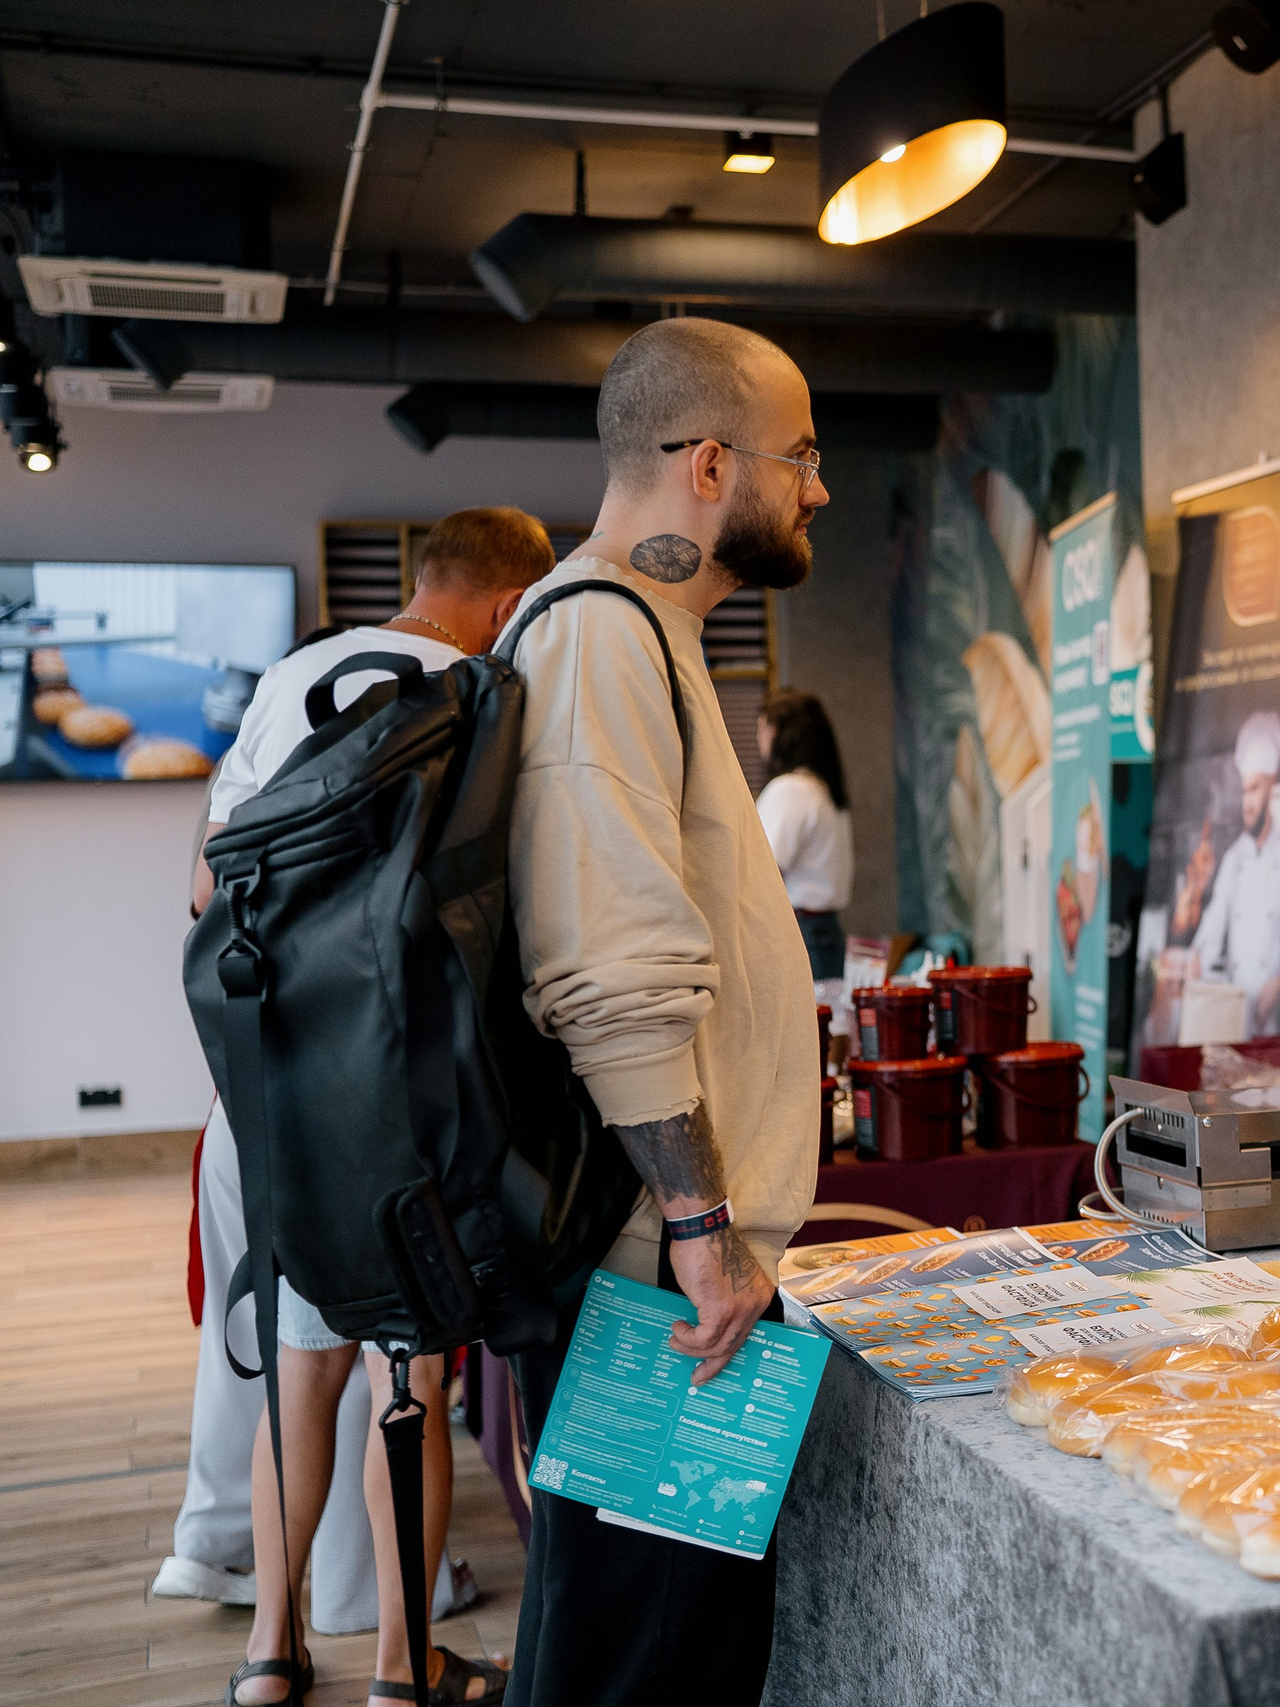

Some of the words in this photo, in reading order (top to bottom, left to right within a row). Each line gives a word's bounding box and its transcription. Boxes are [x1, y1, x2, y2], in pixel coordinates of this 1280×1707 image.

[678, 1415, 721, 1434] Глобальное
[720, 1428, 768, 1449] присутствие
[570, 1468, 607, 1485] Контакты
